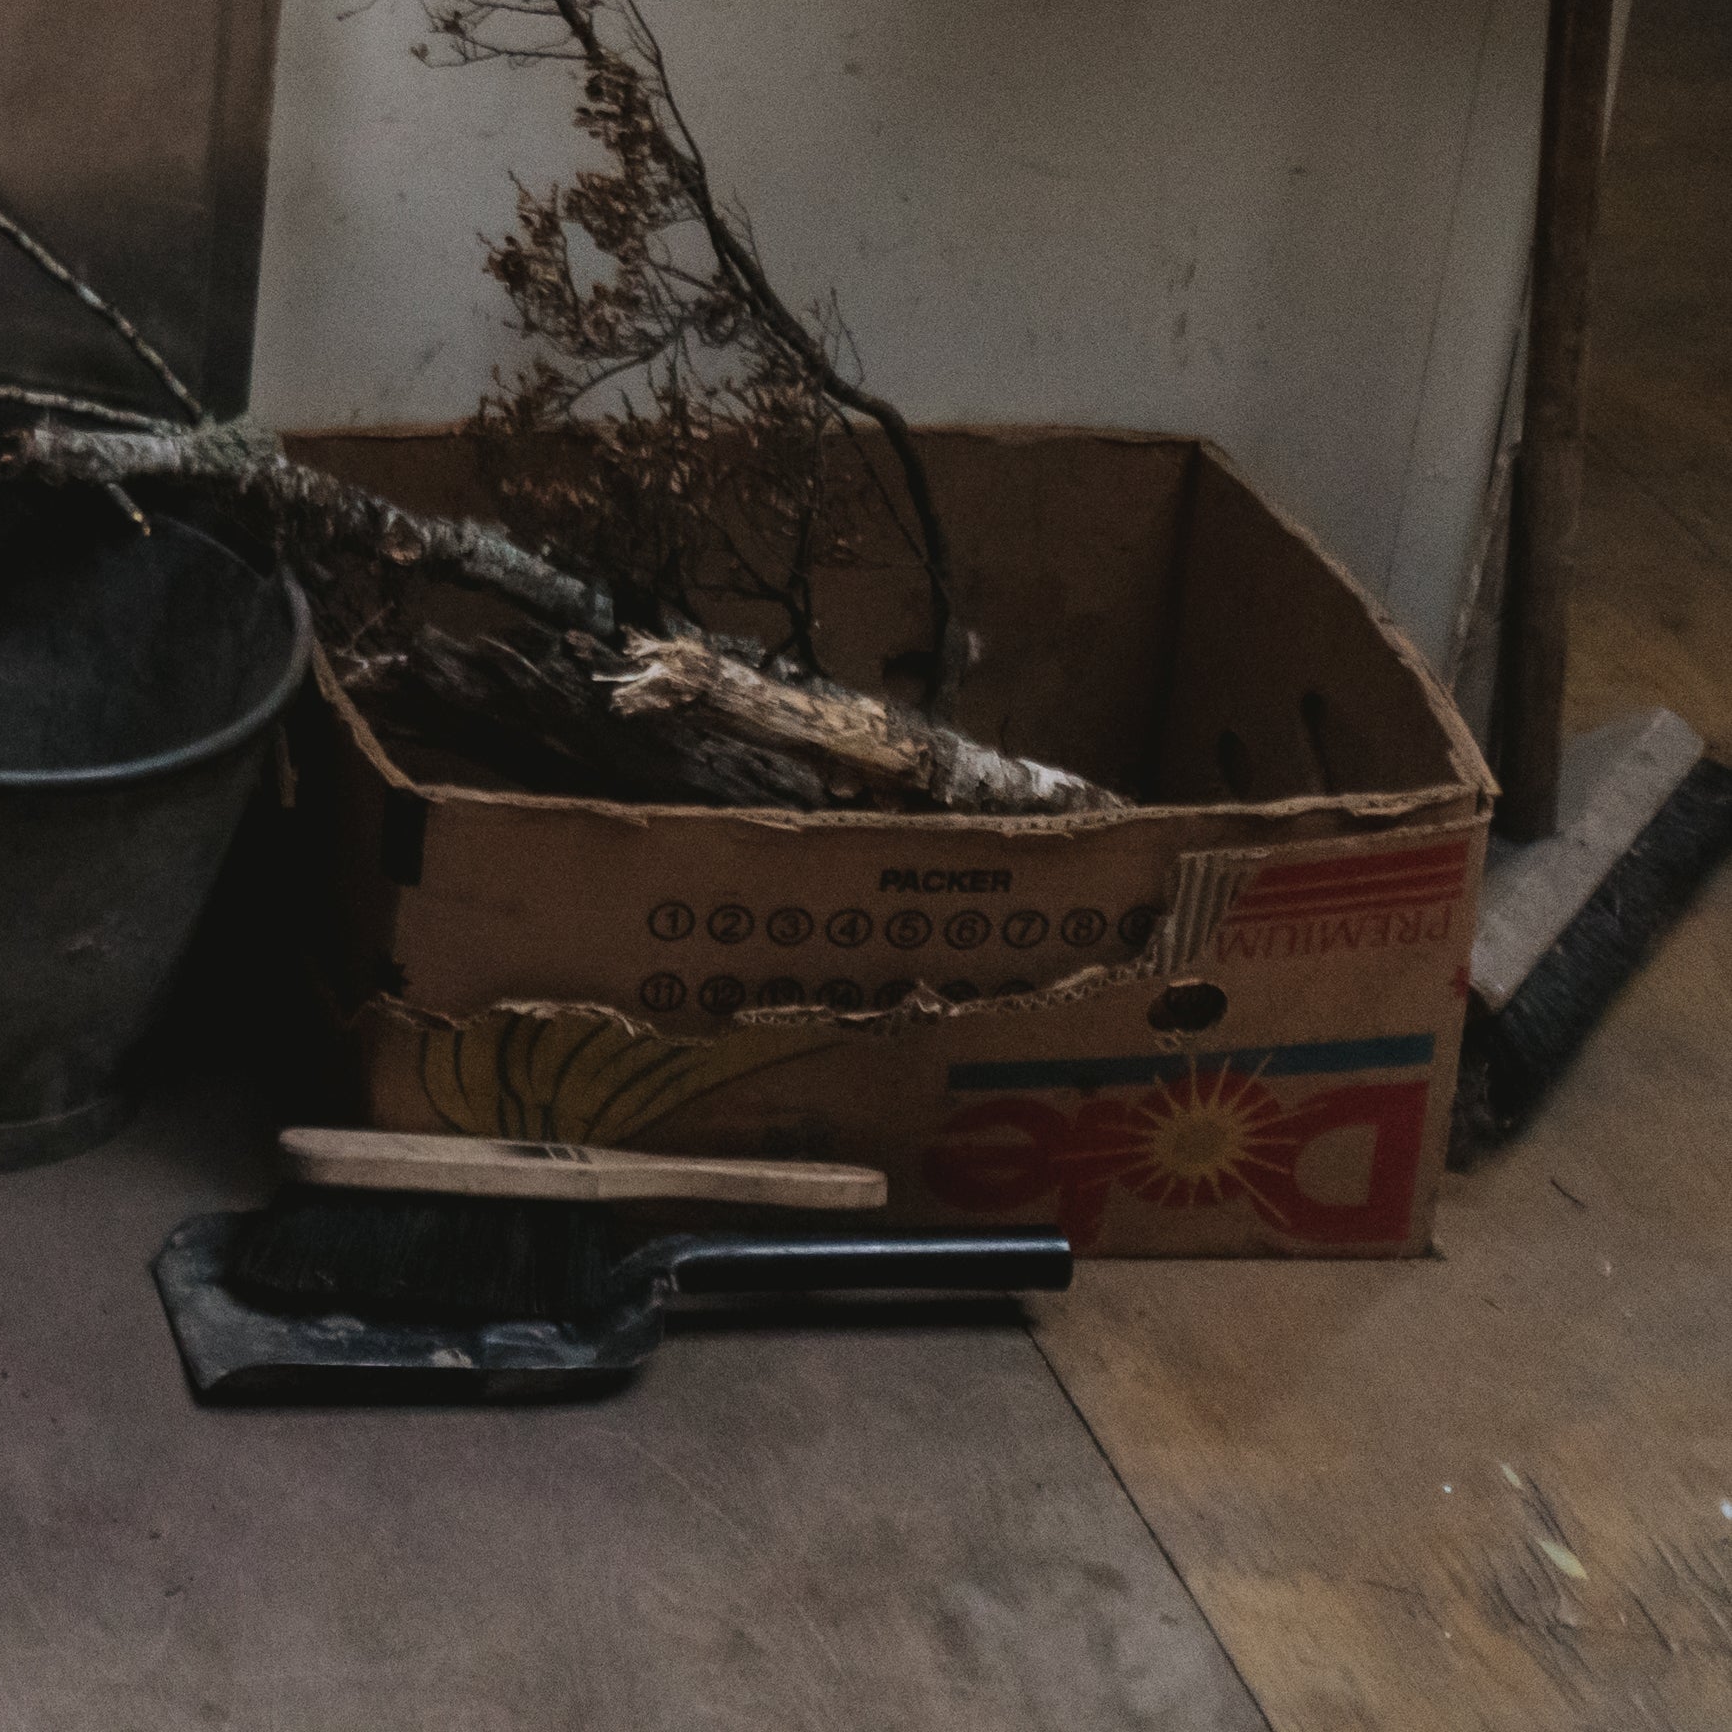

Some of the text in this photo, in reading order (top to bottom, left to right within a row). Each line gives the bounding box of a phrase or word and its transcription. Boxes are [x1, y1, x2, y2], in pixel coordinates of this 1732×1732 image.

[879, 869, 1014, 893] PACKER
[1216, 905, 1453, 963] PREMIUM
[922, 1070, 1429, 1246] Dole
